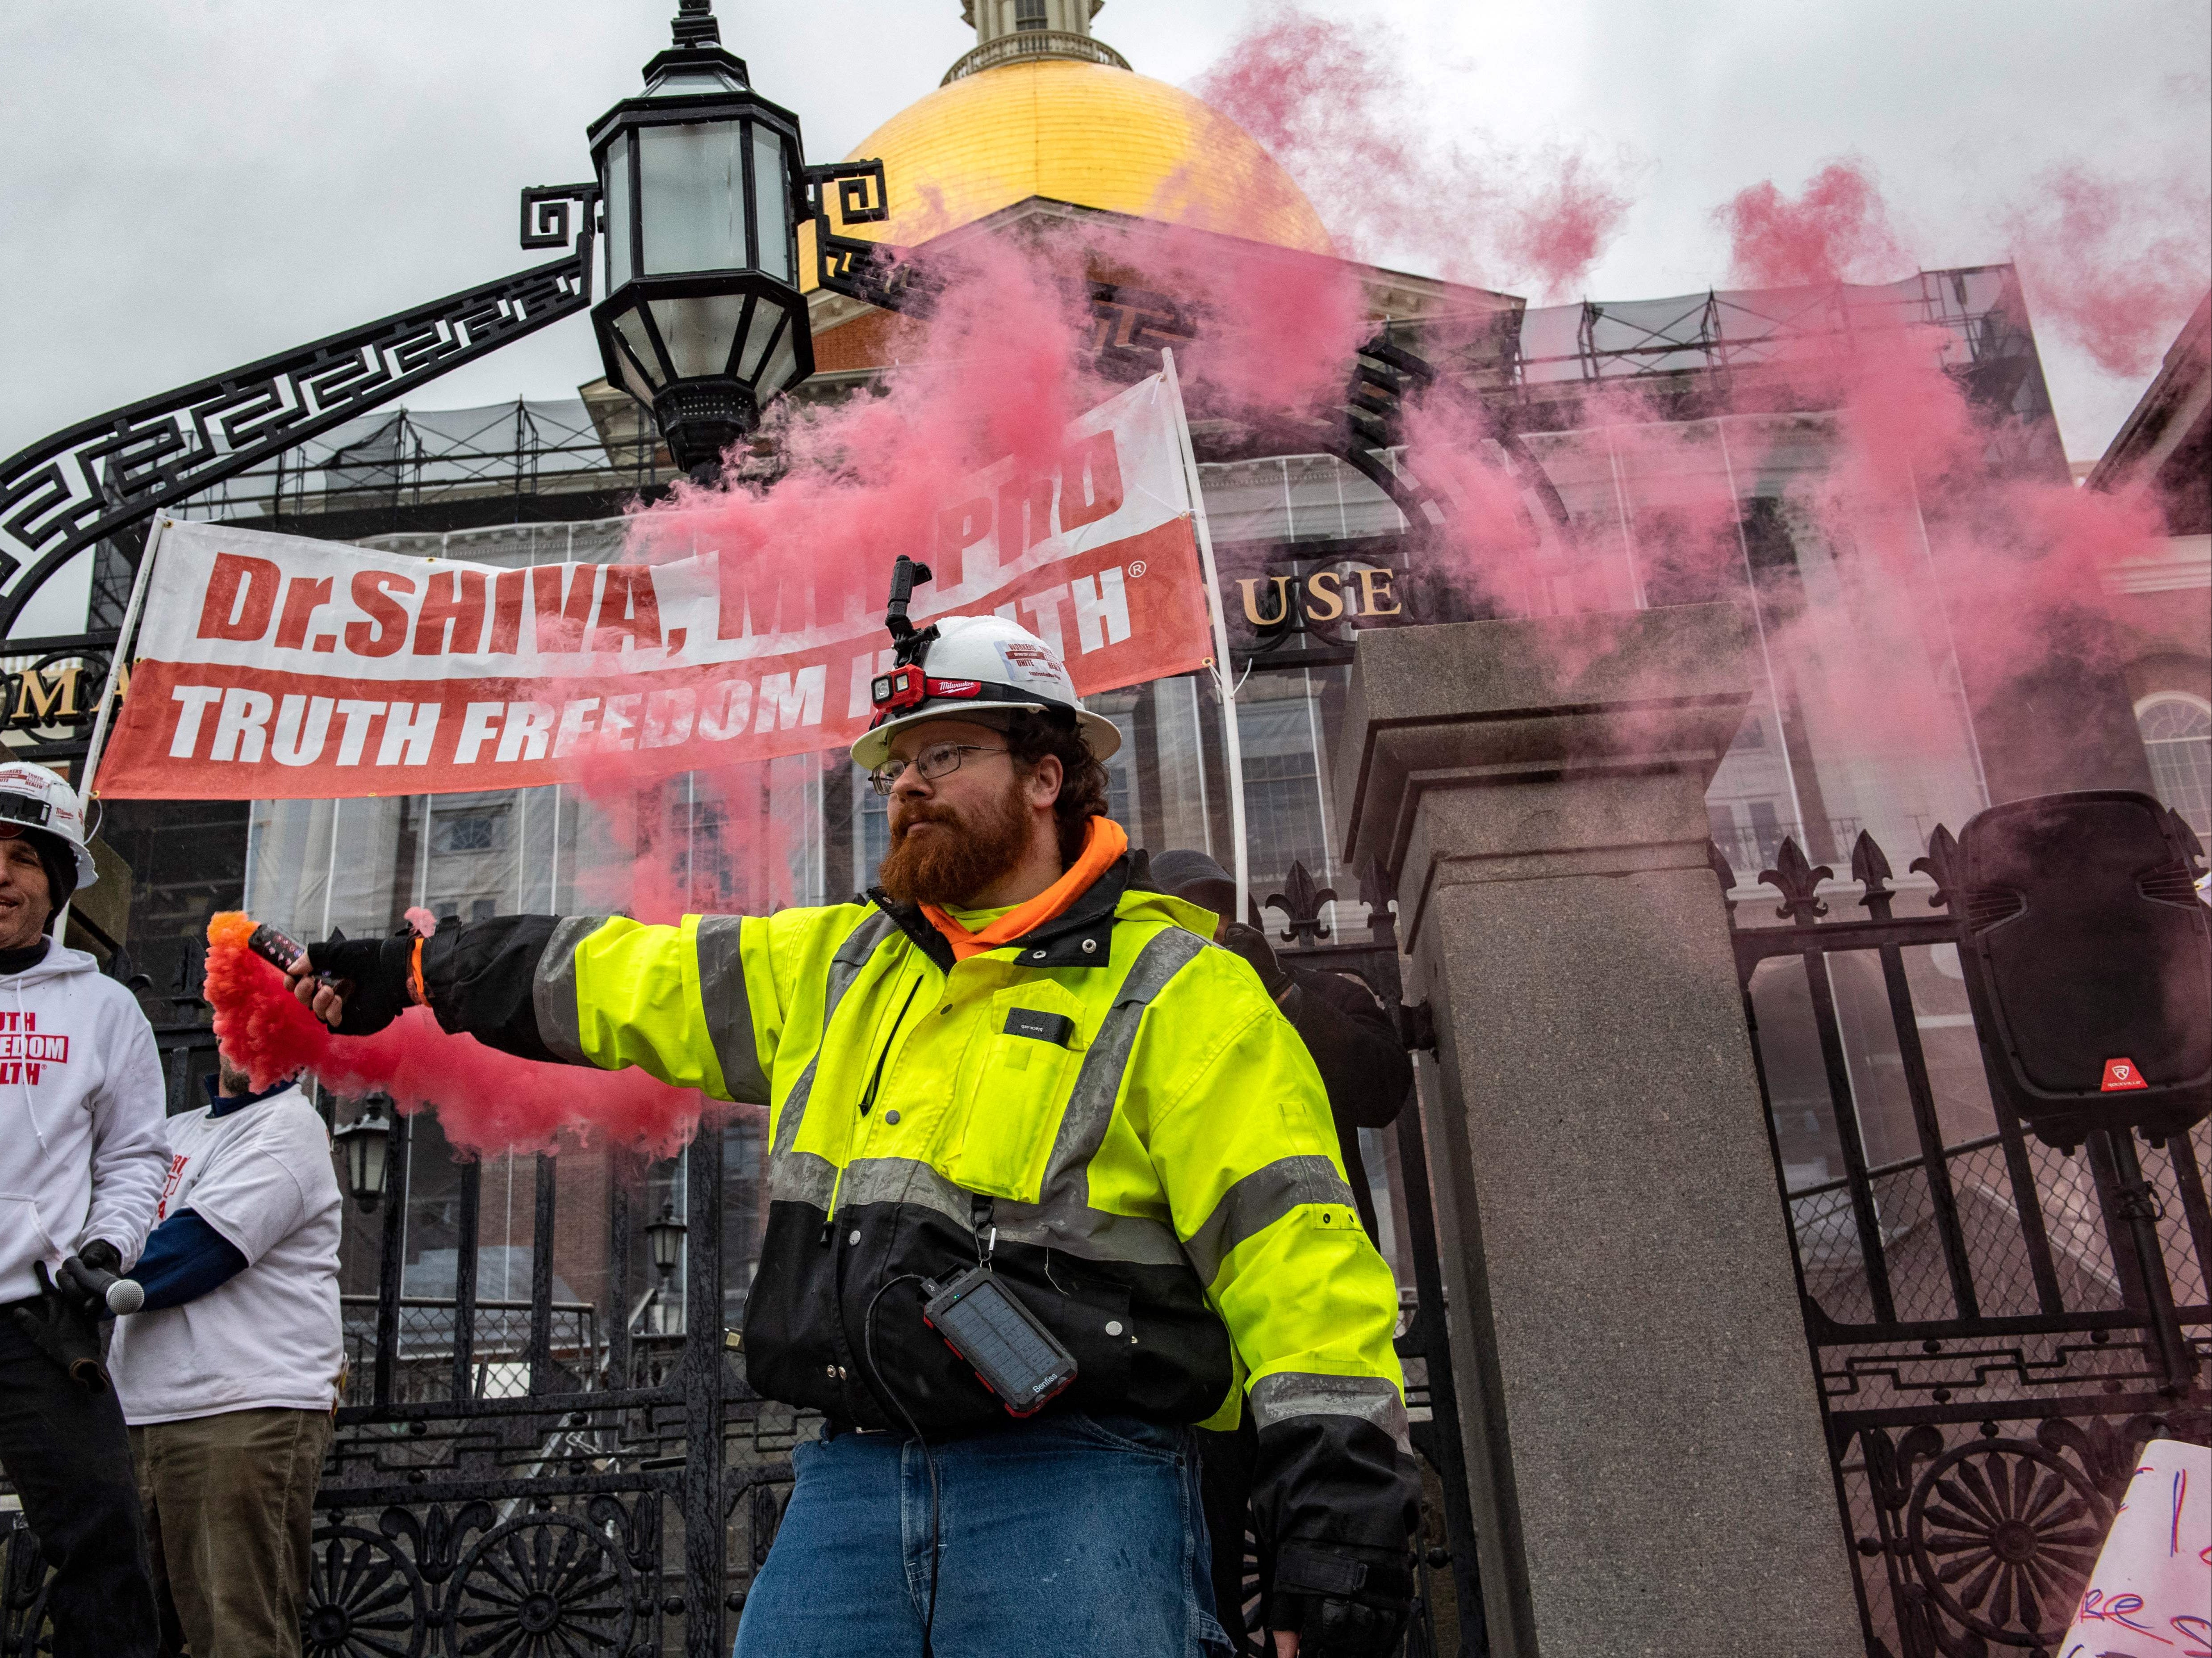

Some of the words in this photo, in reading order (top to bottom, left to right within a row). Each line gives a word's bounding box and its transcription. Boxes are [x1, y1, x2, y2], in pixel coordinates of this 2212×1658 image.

[1204, 568, 1402, 625] USE
[938, 680, 974, 691] Milwaukee
[169, 685, 441, 767] TRUTH
[453, 664, 827, 764] FREEDOM
[1033, 1373, 1058, 1393] Benfiss
